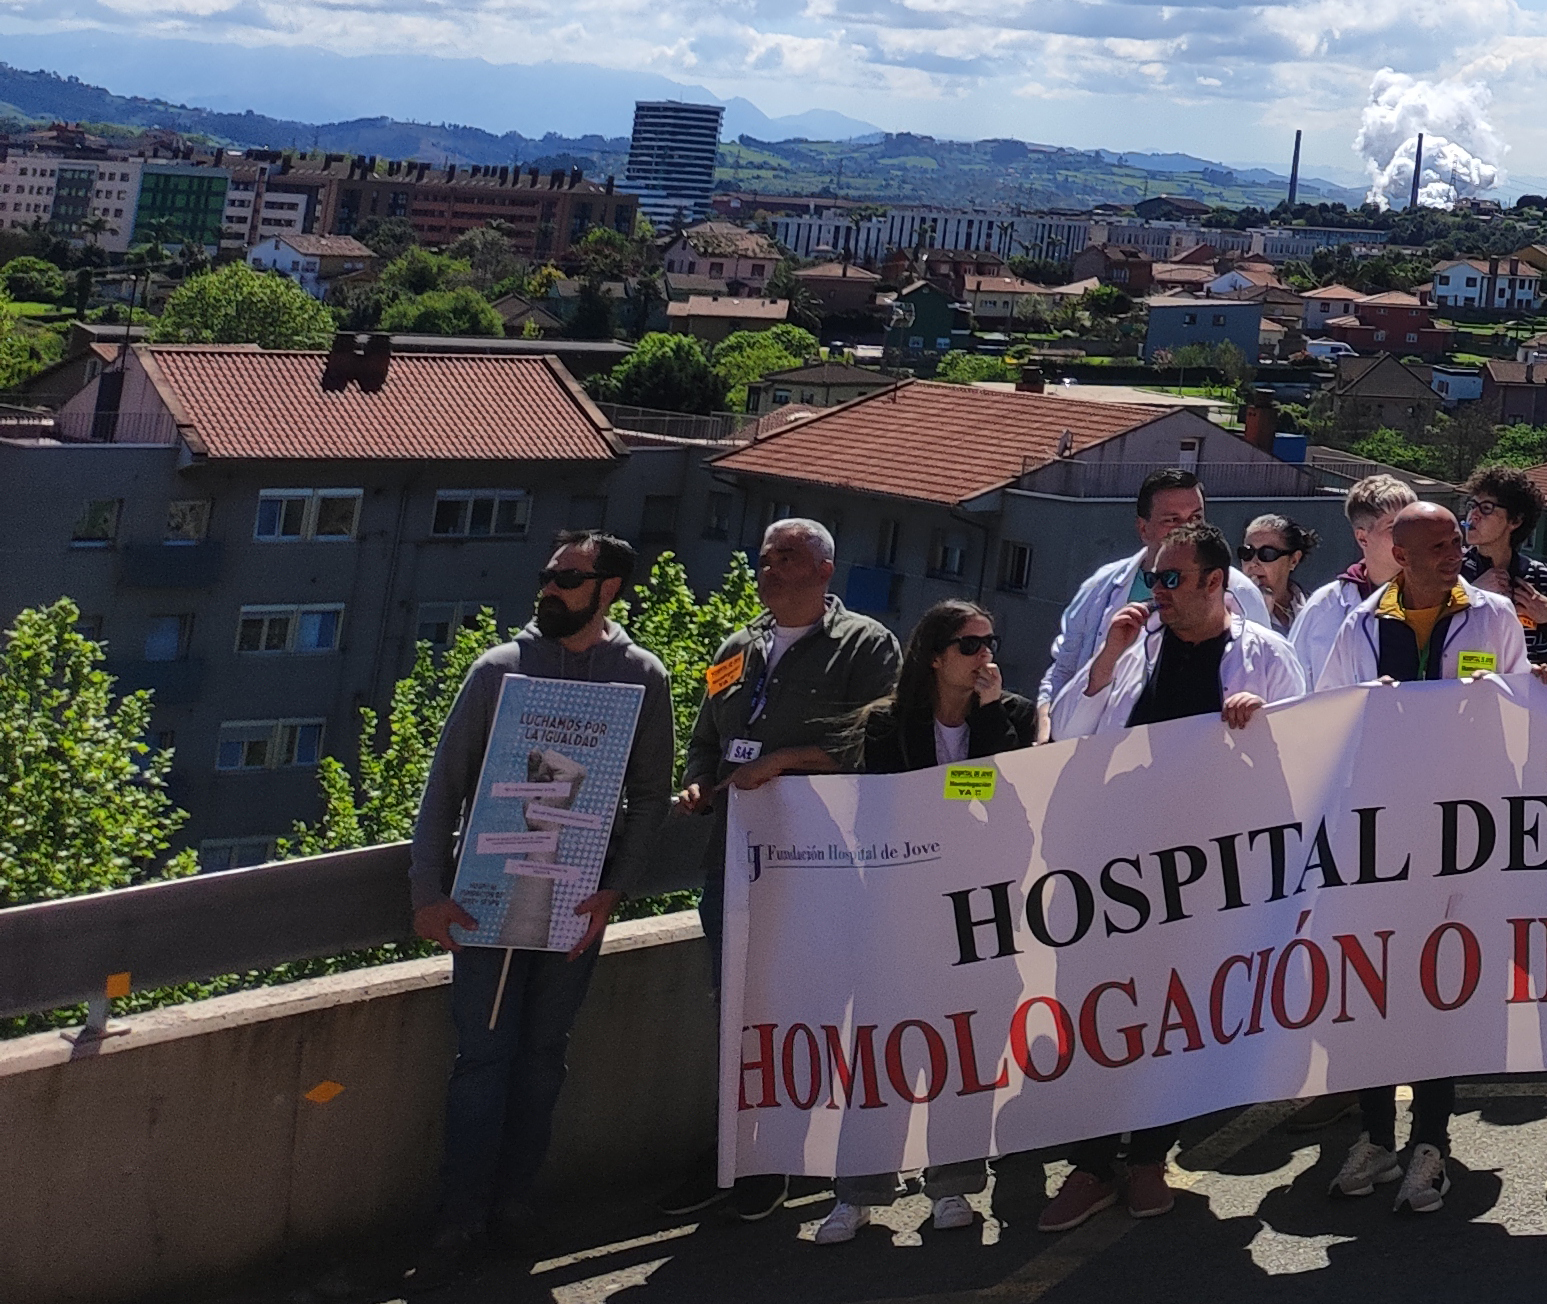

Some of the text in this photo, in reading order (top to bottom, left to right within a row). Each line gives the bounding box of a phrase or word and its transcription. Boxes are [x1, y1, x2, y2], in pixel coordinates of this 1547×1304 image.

[519, 712, 608, 736] LUCHAMOS POR
[524, 728, 599, 748] LA IGUALDAD
[734, 745, 754, 760] SAE
[768, 841, 940, 864] Fundación Hospital de Jove
[942, 806, 1412, 967] HOSPITAL
[737, 910, 1396, 1111] HOMOLOGACIÓN
